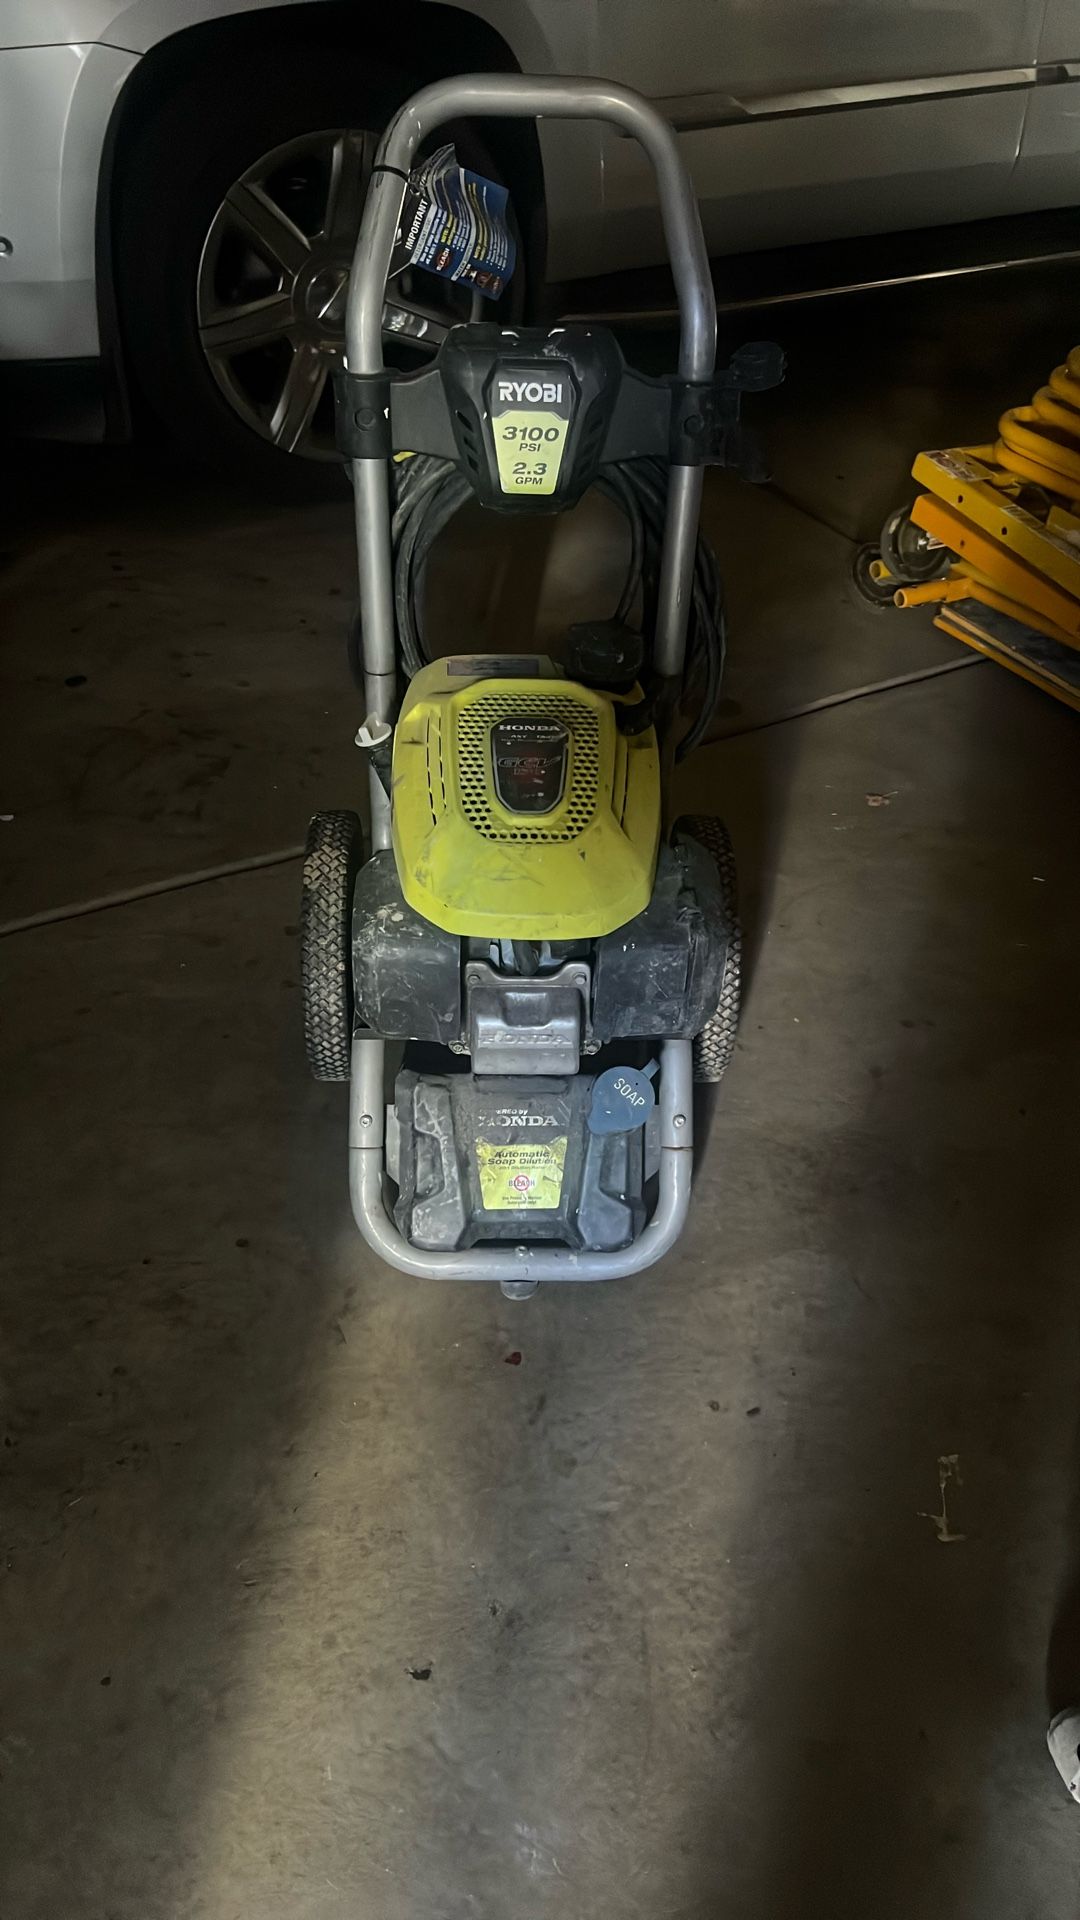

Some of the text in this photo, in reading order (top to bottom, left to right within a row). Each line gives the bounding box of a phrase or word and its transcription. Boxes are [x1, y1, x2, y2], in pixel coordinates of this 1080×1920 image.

[405, 198, 429, 250] IMPORTANT
[498, 381, 563, 403] RYOBI
[502, 426, 560, 442] 3100
[519, 443, 541, 452] PSI
[512, 462, 547, 476] 2.3
[515, 476, 543, 485] GPM
[613, 1078, 646, 1107] SOAP
